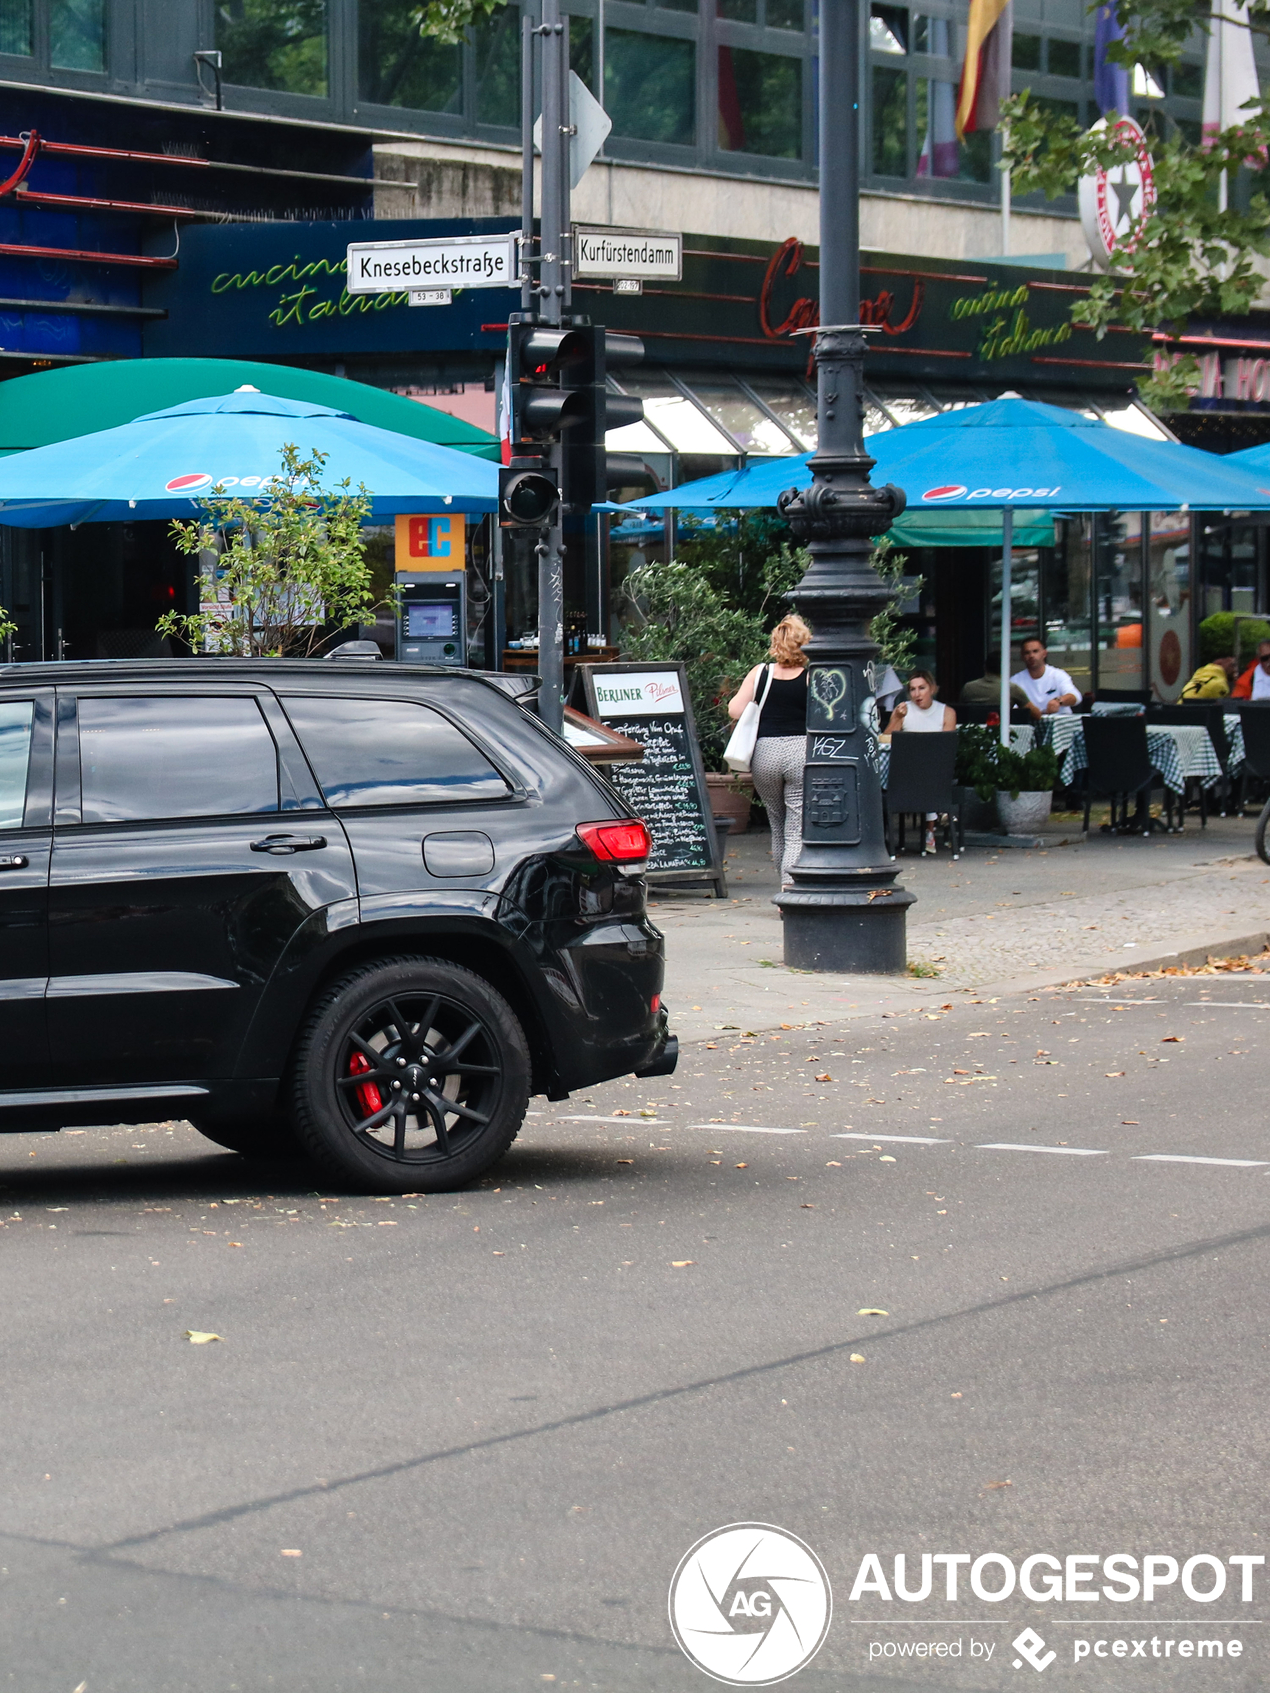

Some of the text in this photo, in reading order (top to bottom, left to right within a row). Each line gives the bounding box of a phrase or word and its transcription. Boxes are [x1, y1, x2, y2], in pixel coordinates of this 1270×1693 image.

[580, 242, 675, 265] Kurfürstendamm
[211, 254, 348, 293] cucin
[360, 253, 504, 278] Knesebeckstraße
[417, 291, 427, 301] 53
[435, 291, 445, 300] 38
[1237, 357, 1270, 402] HO
[966, 486, 1061, 500] pepsi
[596, 682, 679, 703] BERLINER Pilsner
